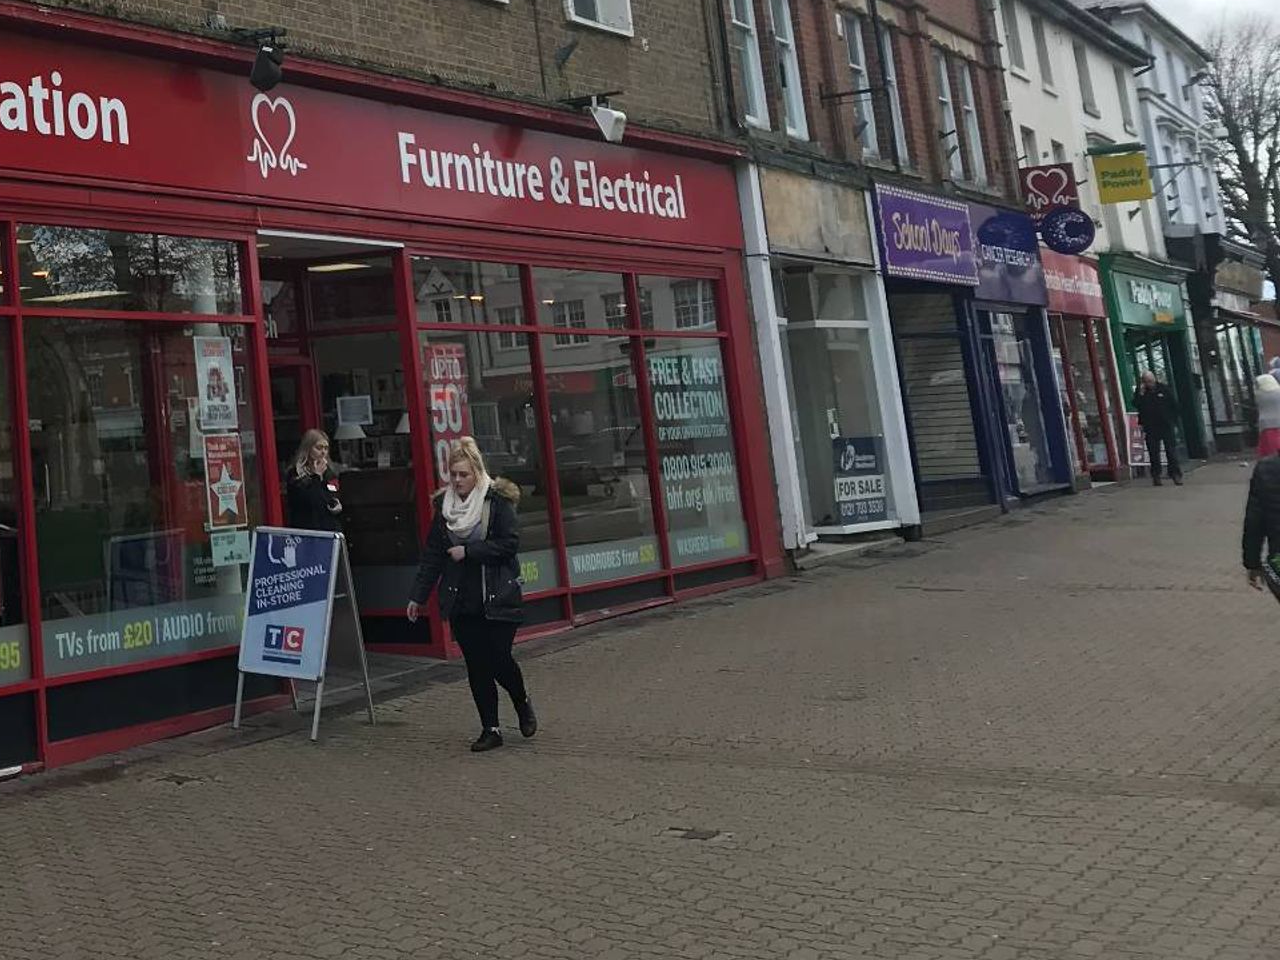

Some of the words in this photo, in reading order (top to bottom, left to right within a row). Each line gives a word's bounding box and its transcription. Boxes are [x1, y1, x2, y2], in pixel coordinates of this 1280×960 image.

[397, 131, 545, 202] Furniture
[548, 155, 572, 204] &
[573, 159, 687, 220] Electrical
[1100, 167, 1143, 181] Paddy
[1102, 178, 1145, 189] Power
[891, 211, 932, 253] School
[931, 218, 962, 265] Days
[430, 358, 446, 380] UP
[446, 358, 461, 380] TO
[650, 357, 681, 386] FREE
[681, 357, 692, 385] &
[691, 357, 720, 385] FAST
[430, 383, 468, 433] 50%
[654, 390, 725, 421] COLLECTION
[662, 455, 691, 481] 0800
[838, 480, 856, 496] FOR
[858, 479, 883, 494] SALE
[572, 549, 621, 574] WARDROBES
[620, 548, 640, 568] from
[254, 564, 327, 589] PROFESSIONAL
[255, 579, 305, 599] CLEANING
[256, 591, 303, 609] IN-STORE
[55, 631, 84, 660] TVs
[86, 629, 120, 655] from
[123, 619, 153, 650] £20
[162, 611, 204, 642] AUDIO
[206, 611, 237, 635] from
